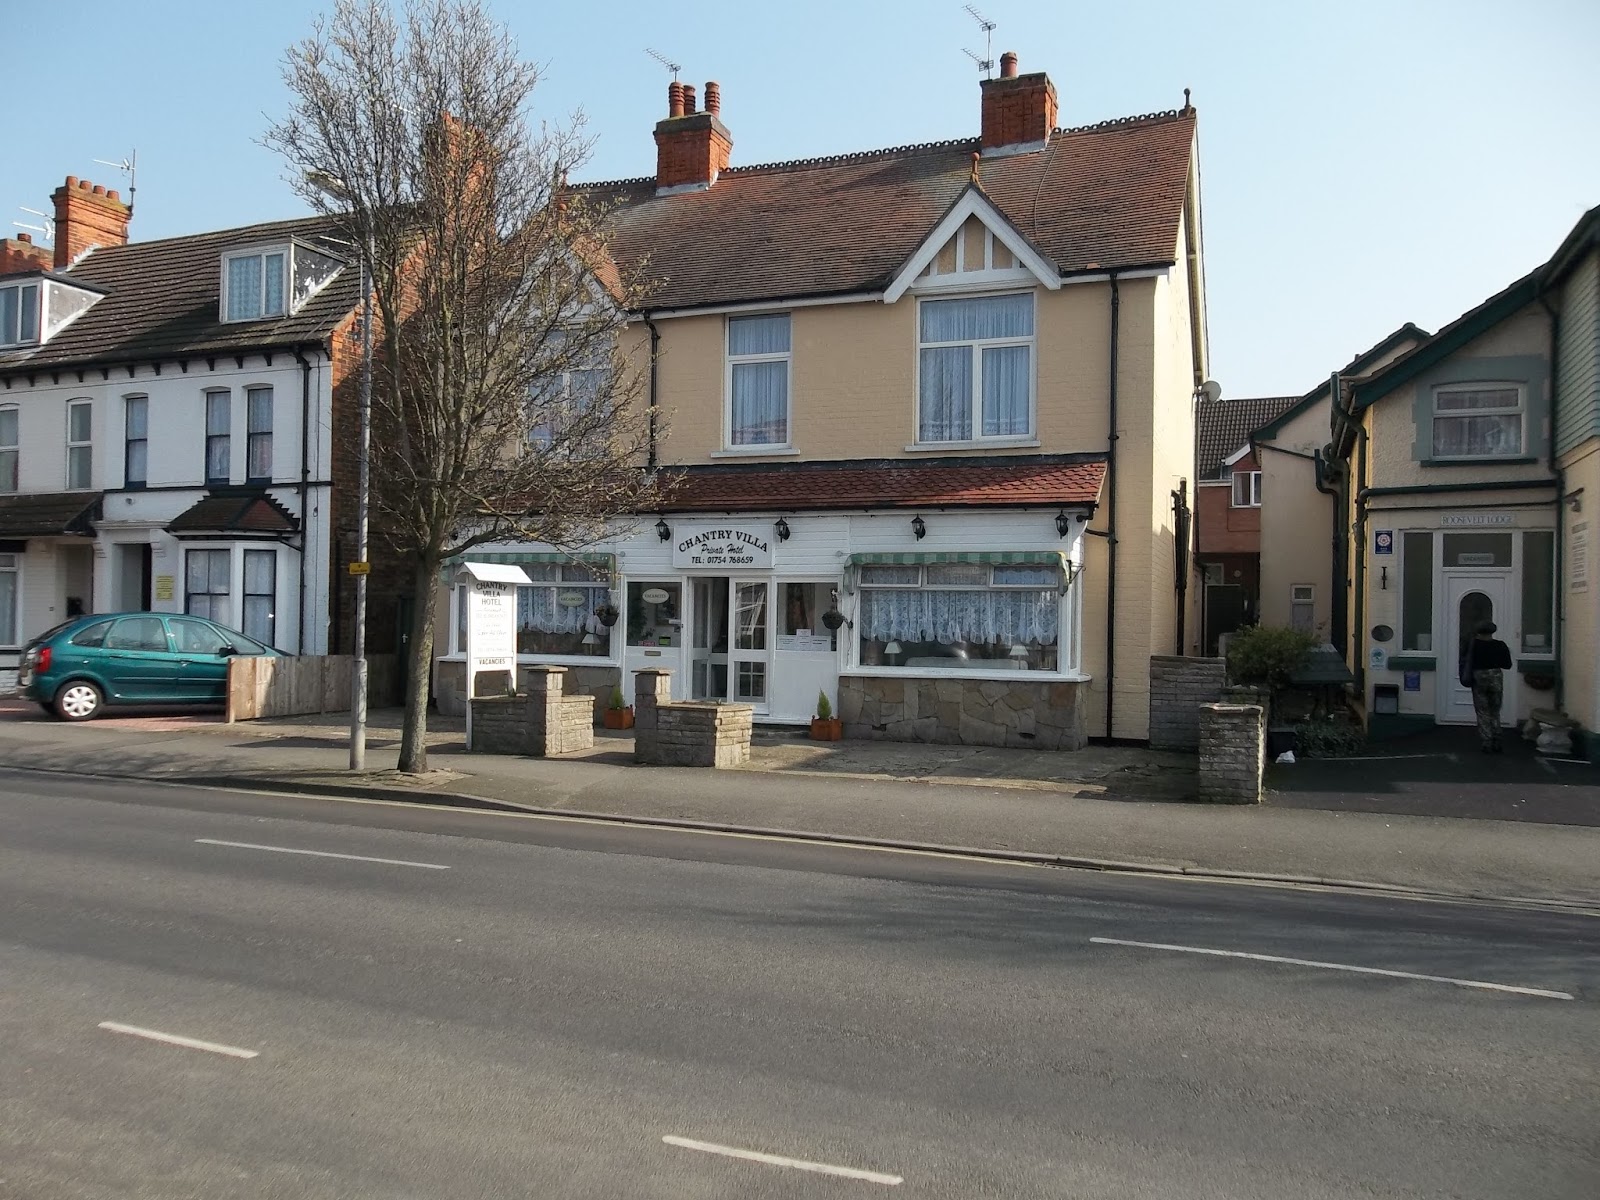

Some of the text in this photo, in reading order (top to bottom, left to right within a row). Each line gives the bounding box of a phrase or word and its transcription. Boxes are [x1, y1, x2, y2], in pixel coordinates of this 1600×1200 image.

[1442, 515, 1512, 524] ROOSEVELT LODGE
[678, 530, 768, 552] CHANTRY VILLA
[701, 543, 745, 555] Private Hotel
[691, 556, 754, 564] TEL: 01754 768659
[476, 582, 507, 591] CHANTRY
[481, 598, 502, 606] HOTEL
